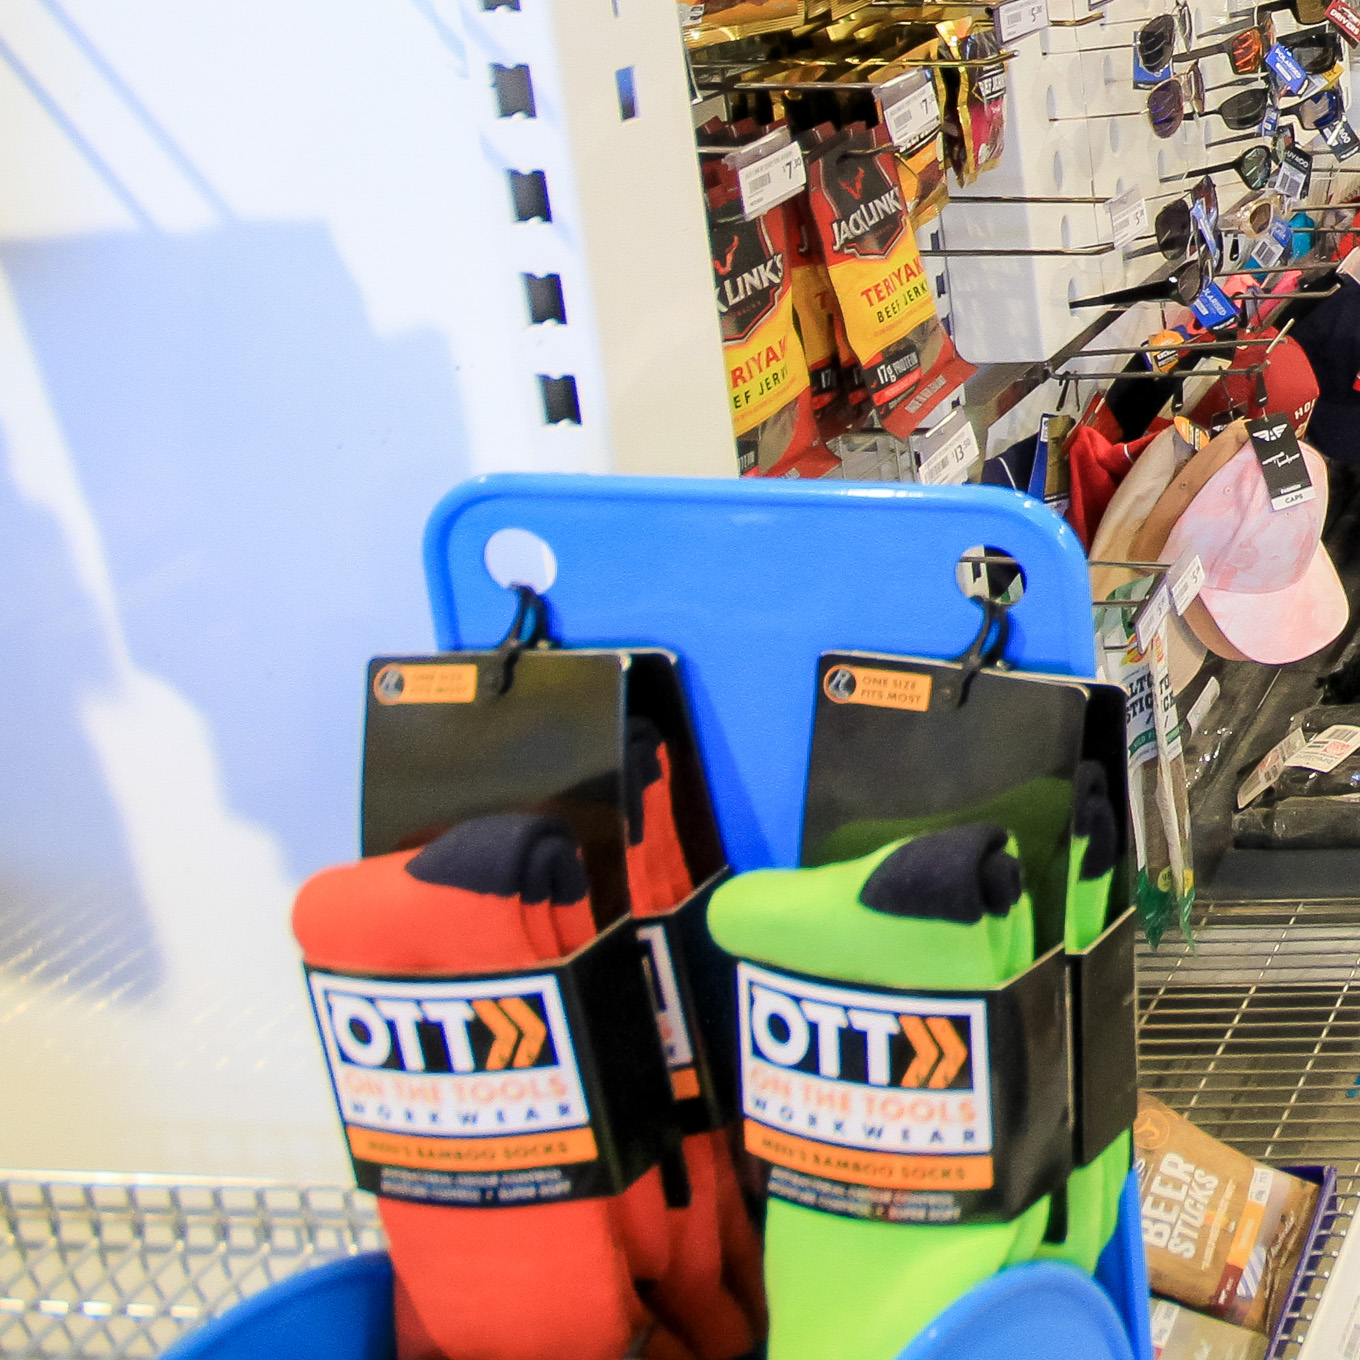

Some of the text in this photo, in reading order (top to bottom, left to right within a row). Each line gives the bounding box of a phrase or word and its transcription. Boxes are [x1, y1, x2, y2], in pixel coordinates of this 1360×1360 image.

[1330, 10, 1360, 37] DRIVERS
[1275, 47, 1302, 80] POLARISED
[782, 158, 802, 181] $7.50
[832, 213, 864, 252] JACK
[877, 300, 901, 324] BEEF
[1285, 494, 1304, 504] CAPS
[859, 688, 922, 705] FITS MOST
[861, 676, 918, 691] ONE SIZE
[327, 994, 476, 1072] OTT
[751, 986, 902, 1087] OTT
[345, 1073, 568, 1104] ON THE TOOLS
[750, 1065, 977, 1124] ON THE TOOLS
[417, 1143, 568, 1160] BAMBOO SOCKS
[813, 1153, 894, 1179] BAMBOO
[899, 1165, 966, 1182] SOCKS
[1141, 1151, 1196, 1249] BEER
[1167, 1168, 1220, 1260] STICKS
